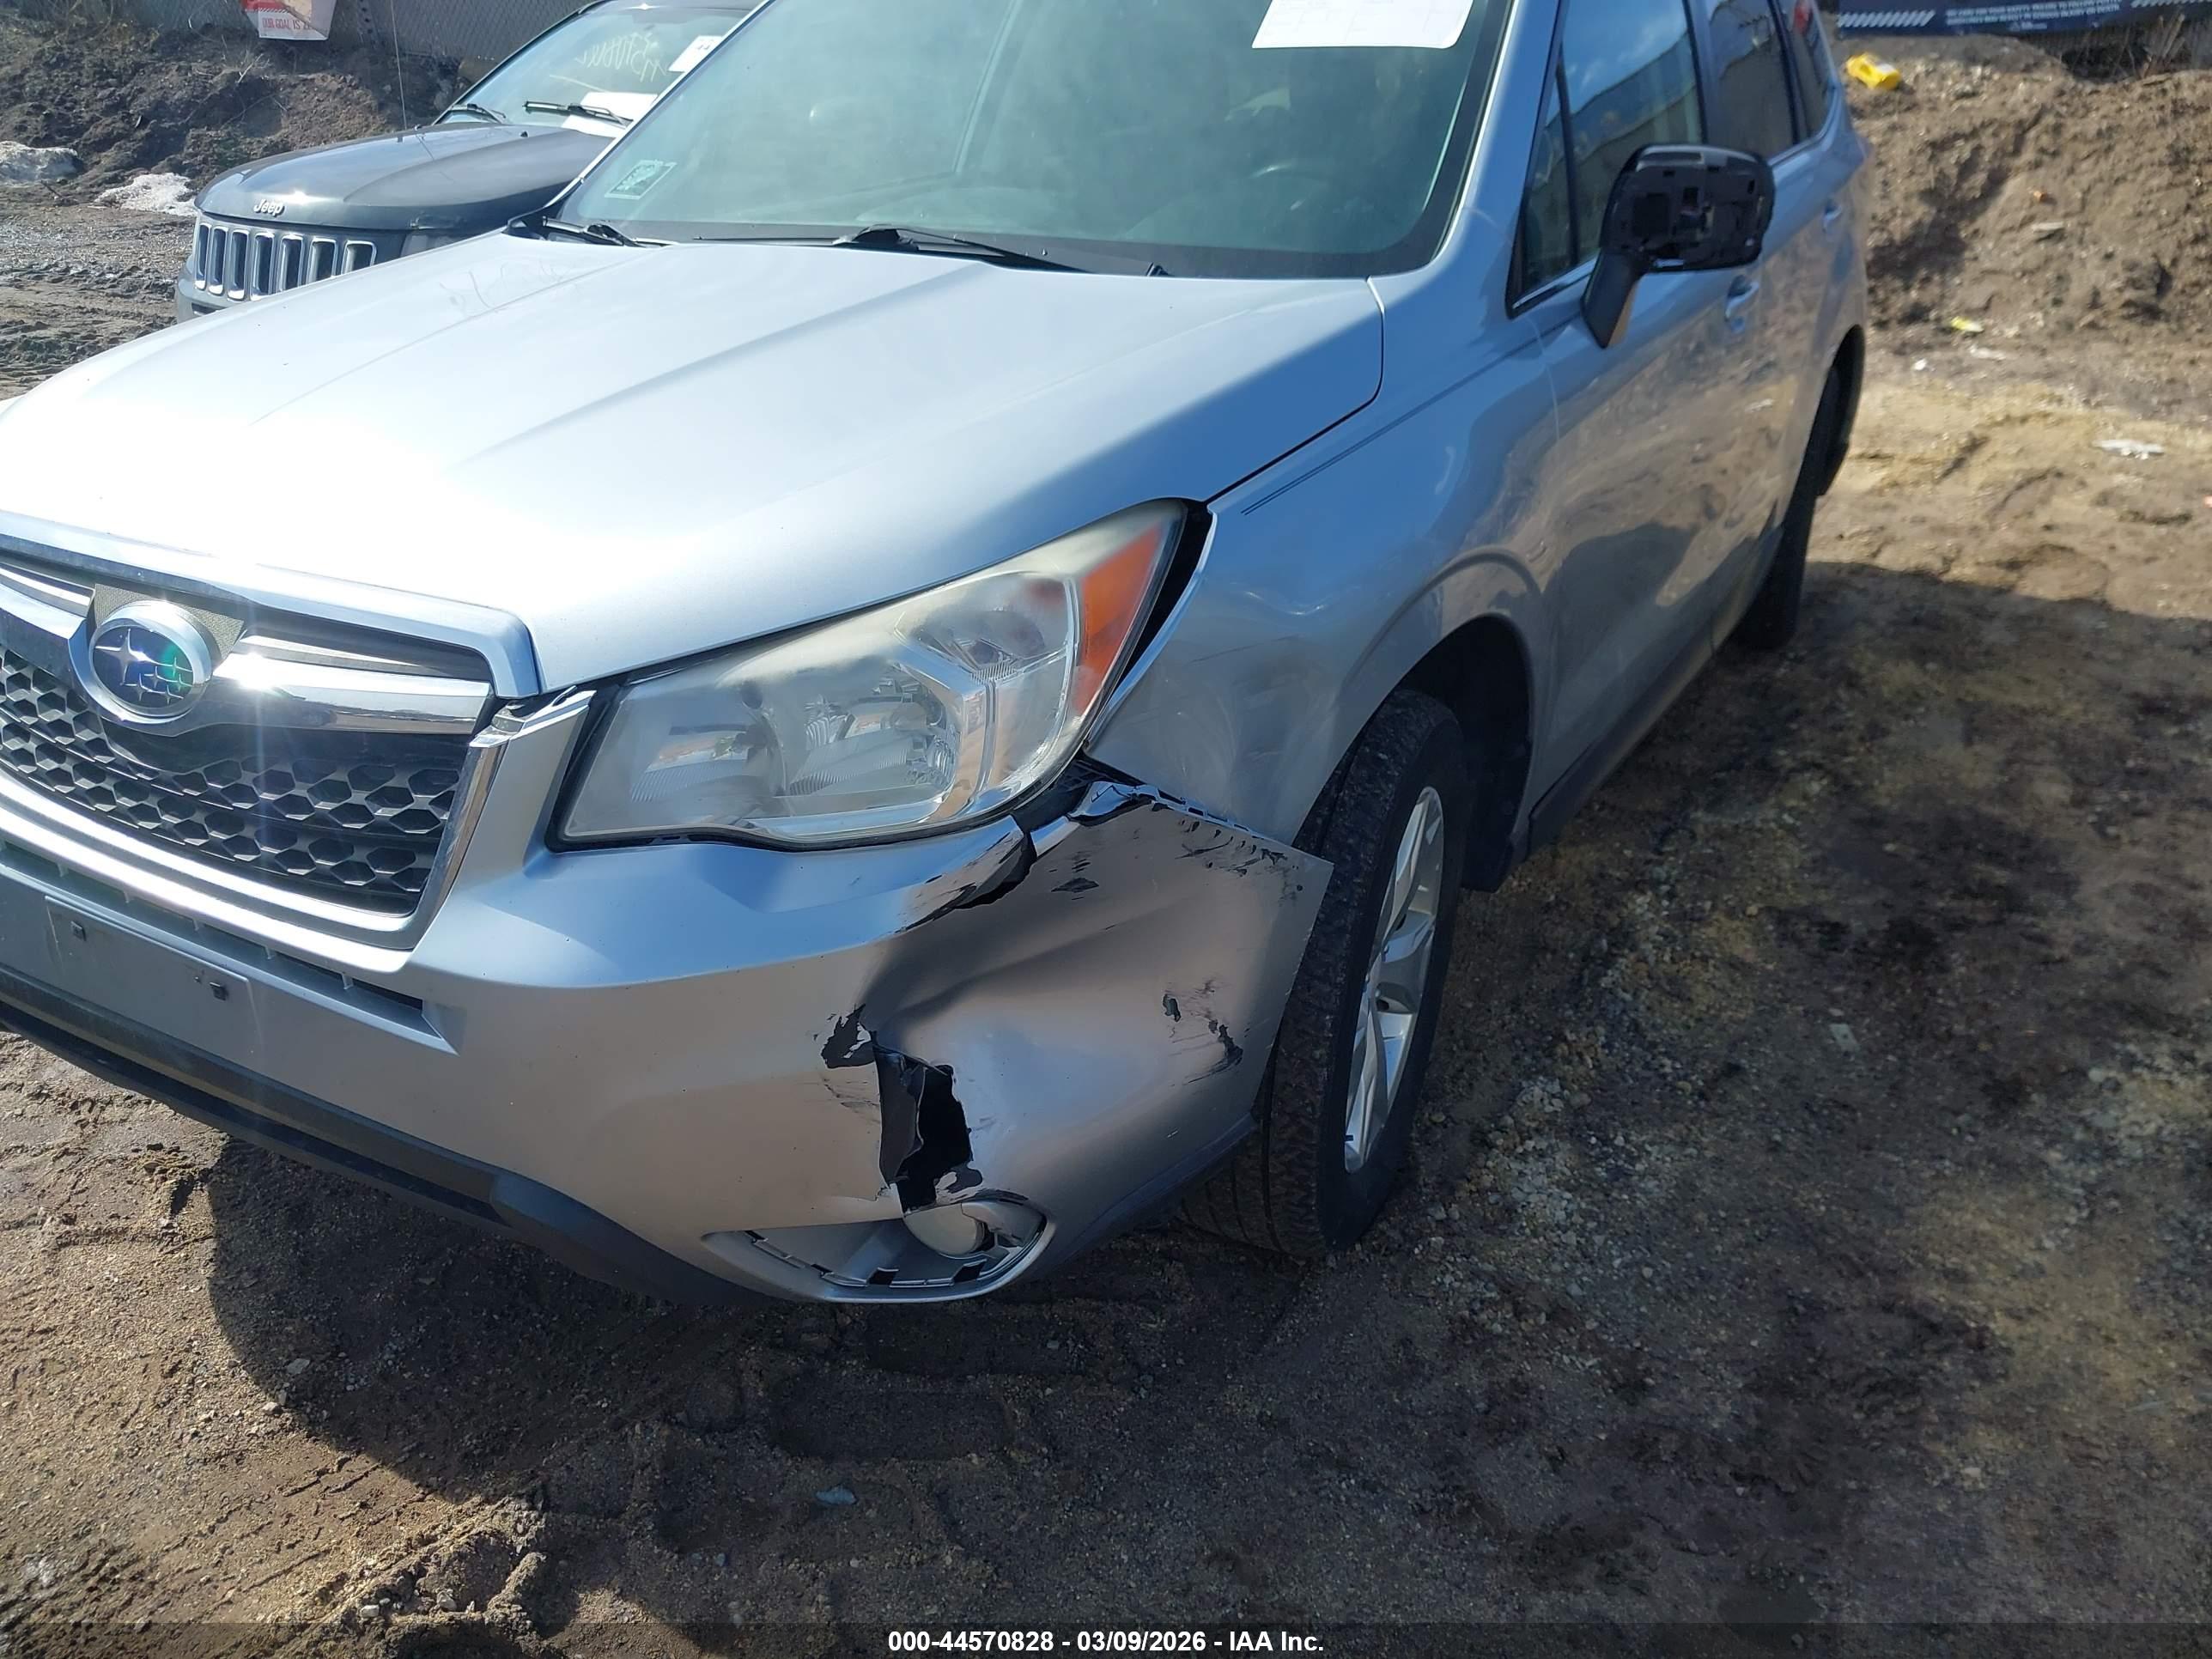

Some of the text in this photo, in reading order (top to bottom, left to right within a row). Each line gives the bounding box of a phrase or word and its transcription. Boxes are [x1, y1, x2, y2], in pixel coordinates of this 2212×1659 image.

[263, 18, 274, 27] OUR
[276, 19, 289, 28] GOAL
[293, 20, 301, 29] IS
[253, 198, 284, 216] Jeep
